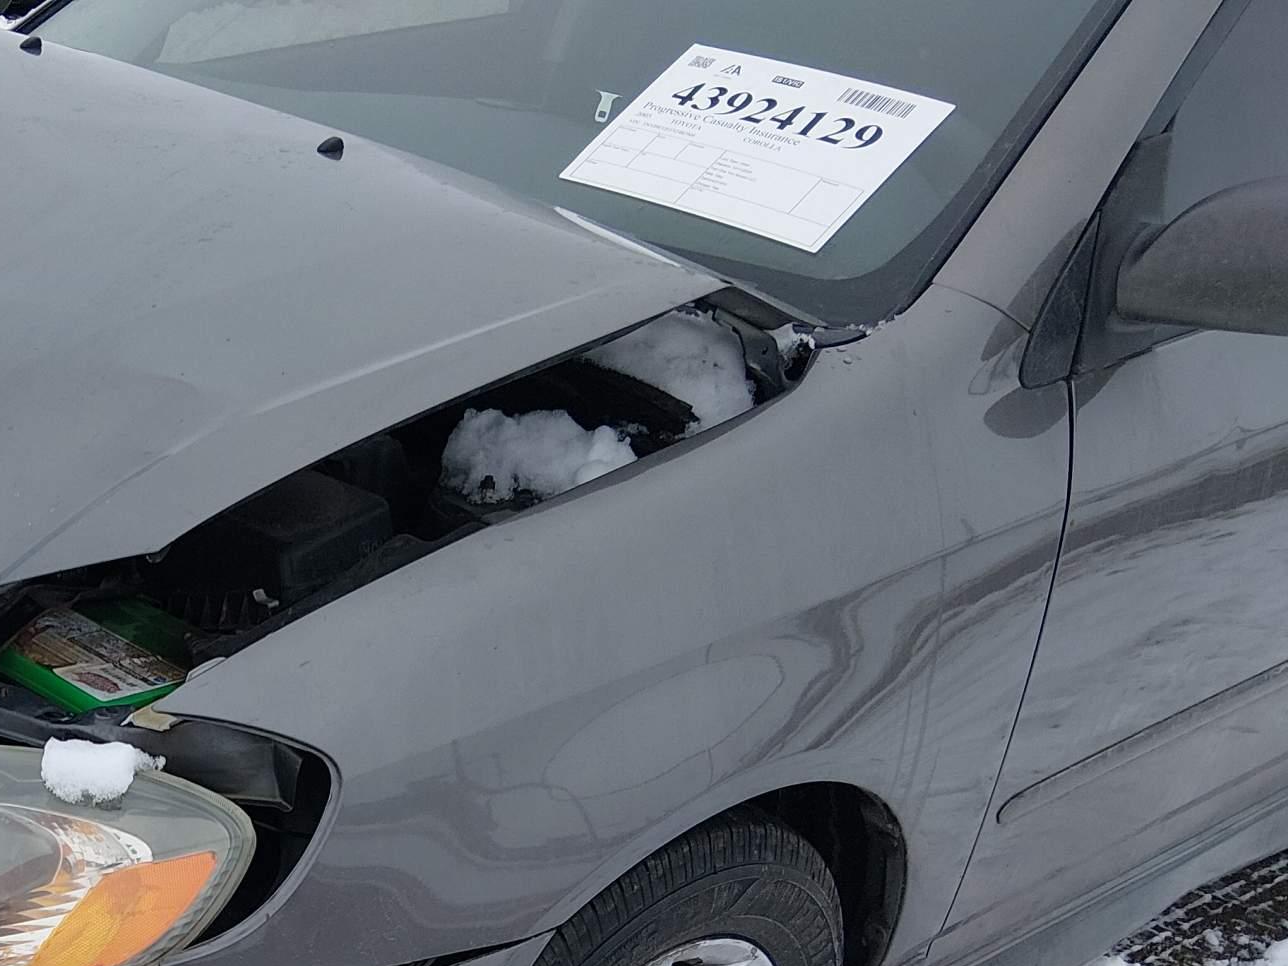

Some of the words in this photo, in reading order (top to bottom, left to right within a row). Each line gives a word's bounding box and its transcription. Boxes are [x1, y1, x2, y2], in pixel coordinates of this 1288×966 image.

[643, 101, 702, 121] Progressive
[703, 115, 749, 134] Casualty
[749, 126, 801, 146] Insurance
[670, 119, 702, 131] TOYOTA
[743, 137, 782, 152] COROLLA
[671, 82, 884, 150] 43924129
